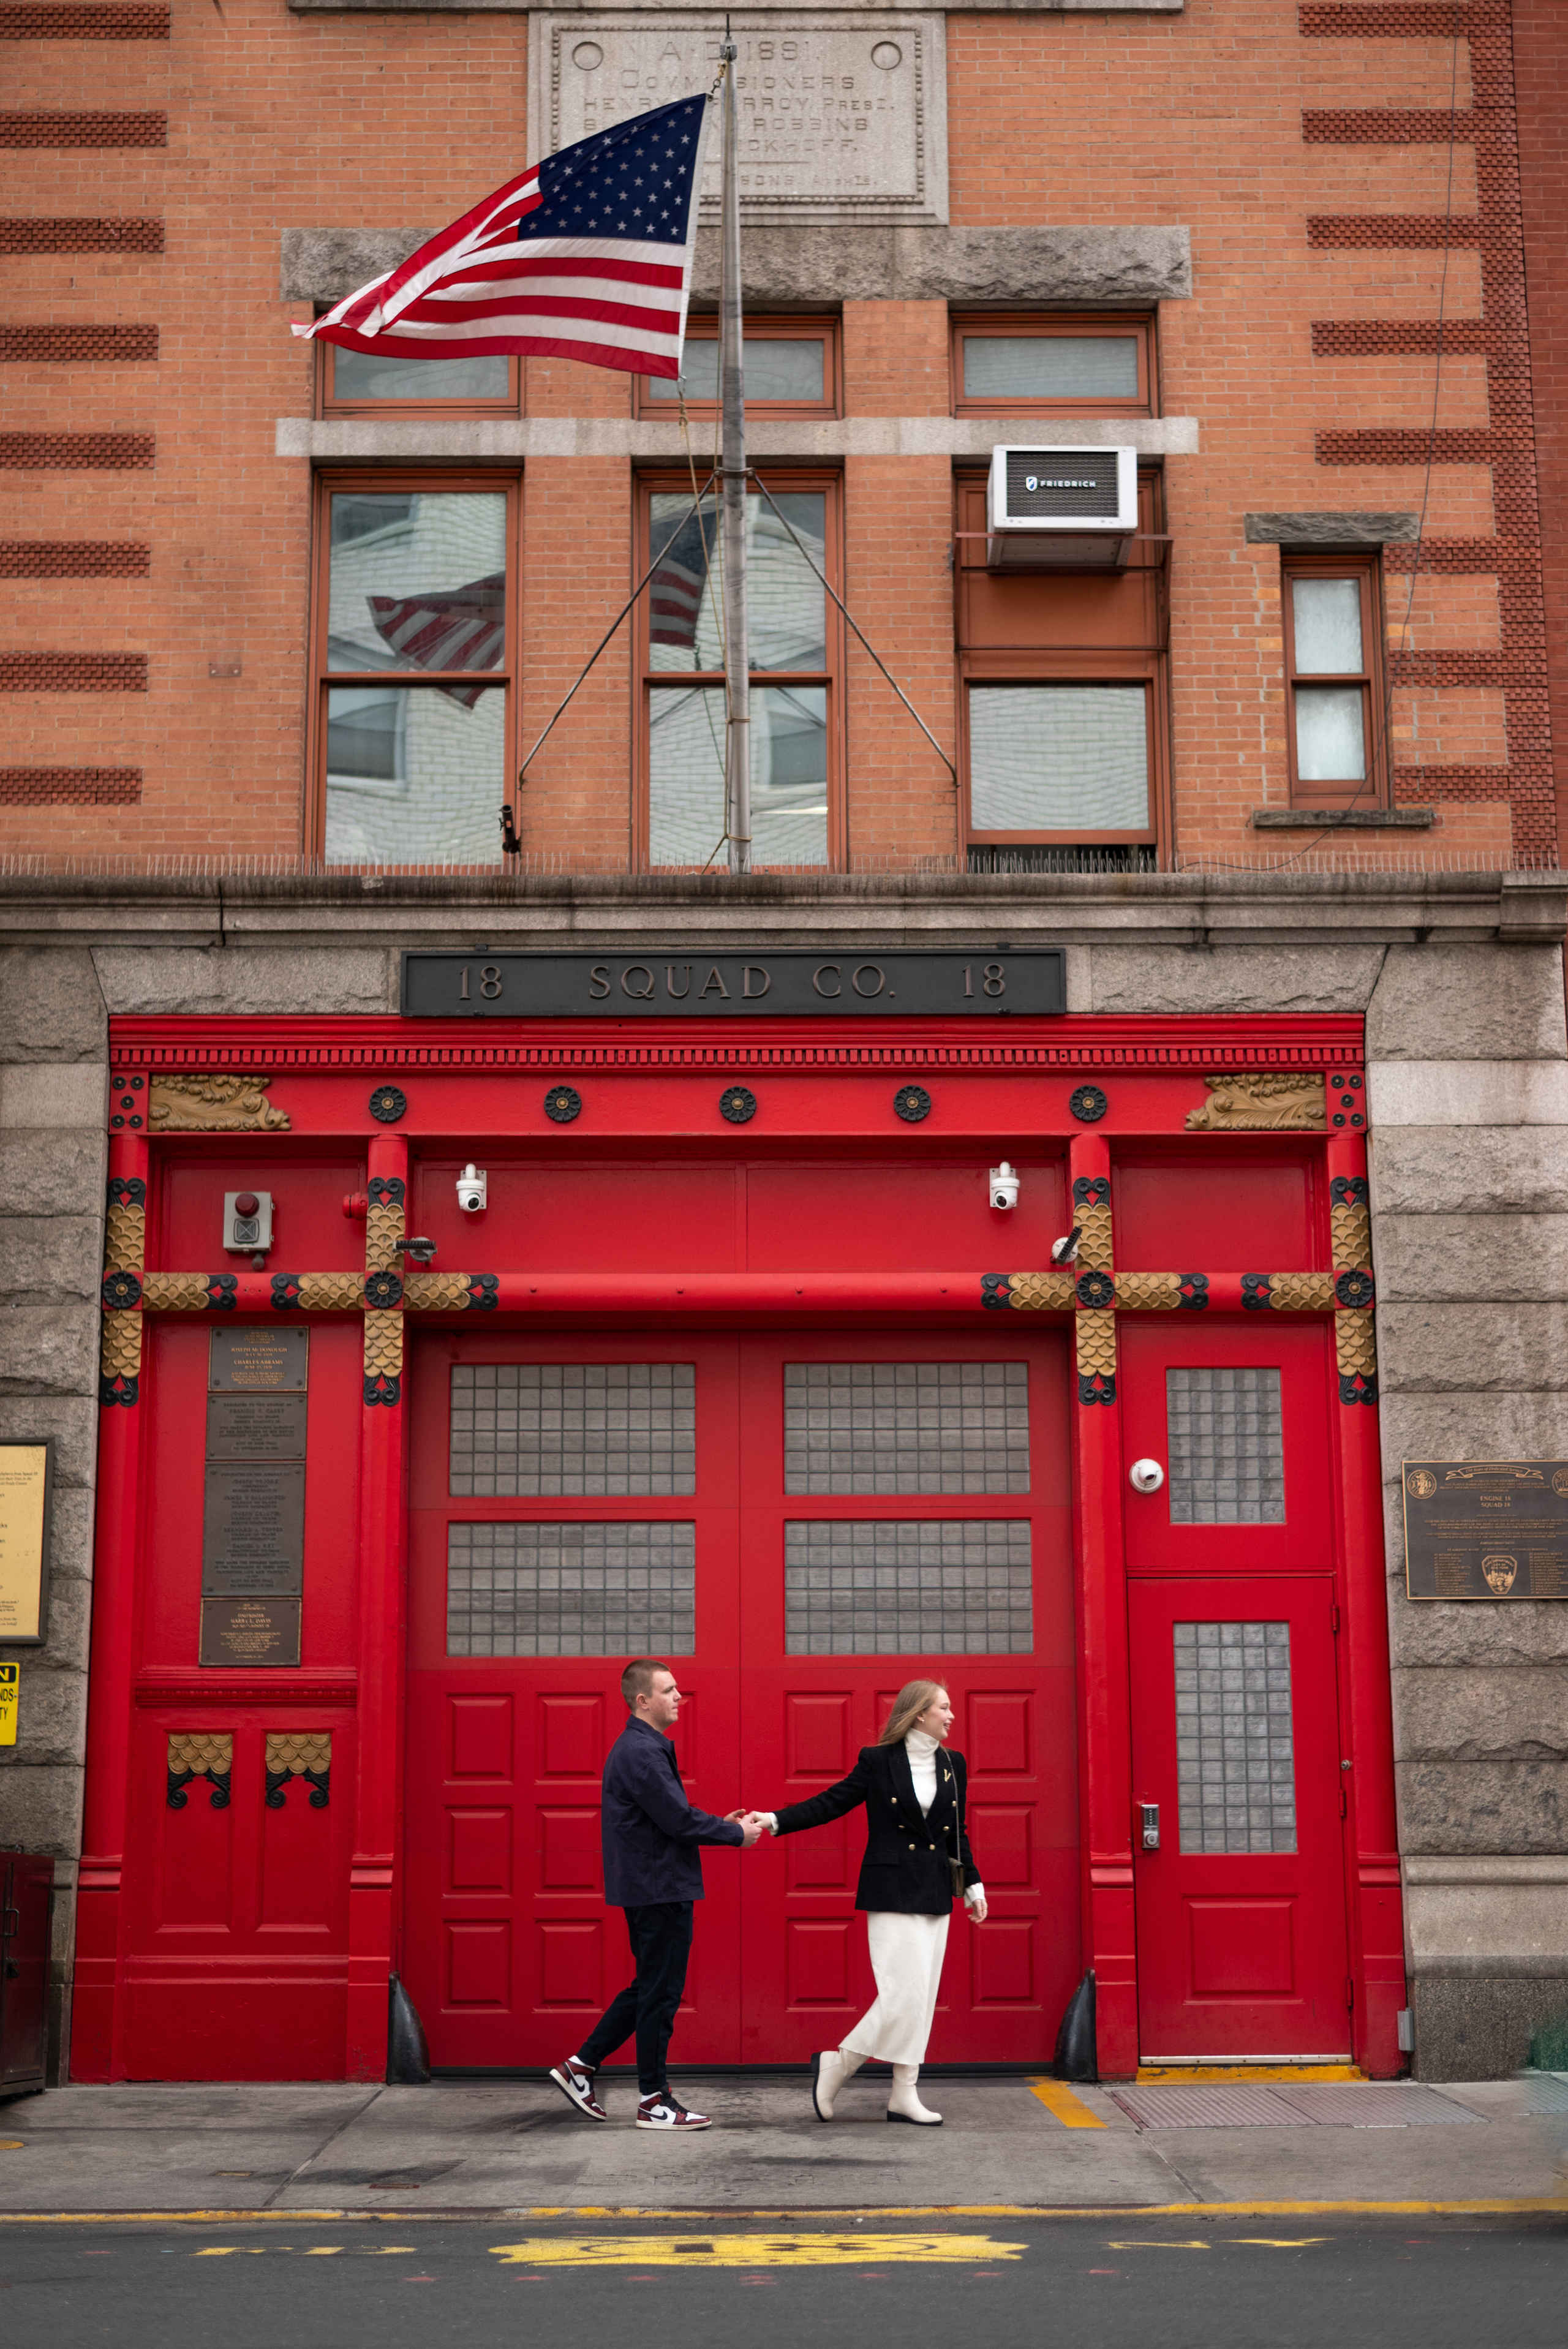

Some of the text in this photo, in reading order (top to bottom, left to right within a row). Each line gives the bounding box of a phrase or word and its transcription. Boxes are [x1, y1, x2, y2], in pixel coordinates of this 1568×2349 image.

[458, 963, 1006, 1000] 18 SQUAD CO. 18
